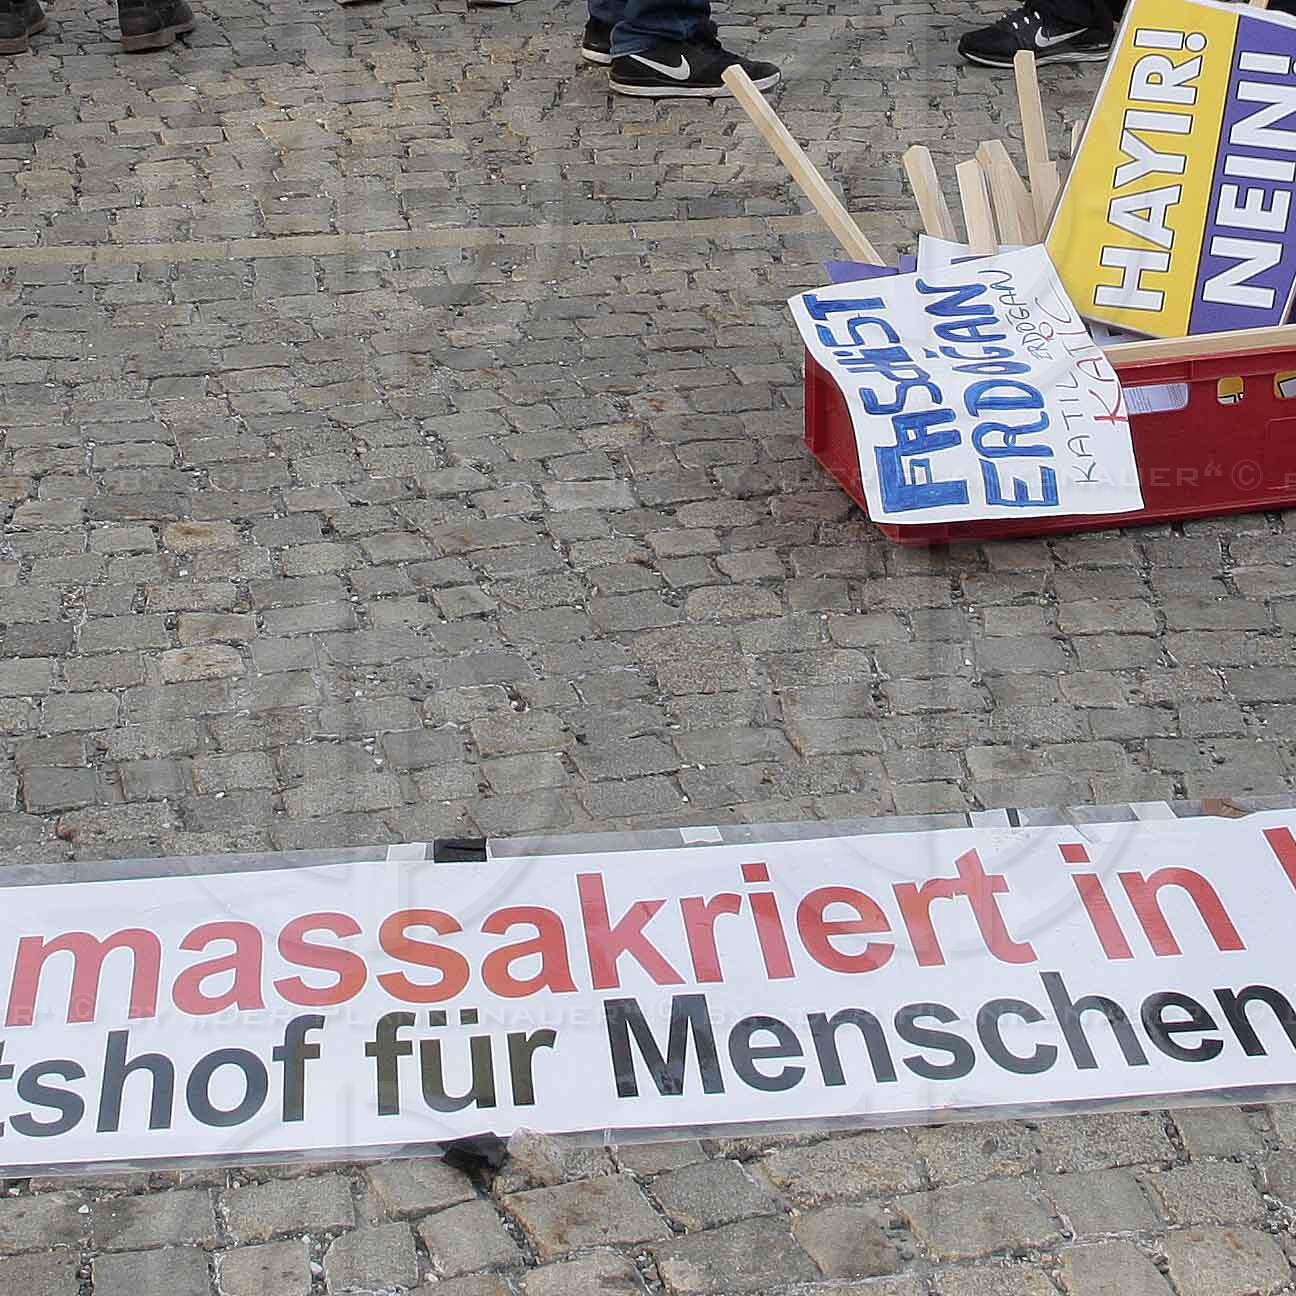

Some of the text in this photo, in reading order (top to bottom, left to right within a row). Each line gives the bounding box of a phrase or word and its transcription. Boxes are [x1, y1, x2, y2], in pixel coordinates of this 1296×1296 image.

[1092, 25, 1208, 314] HAYIR!
[4, 847, 1039, 1028] massakriert
[1058, 842, 1247, 961] in
[363, 1007, 557, 1118] für
